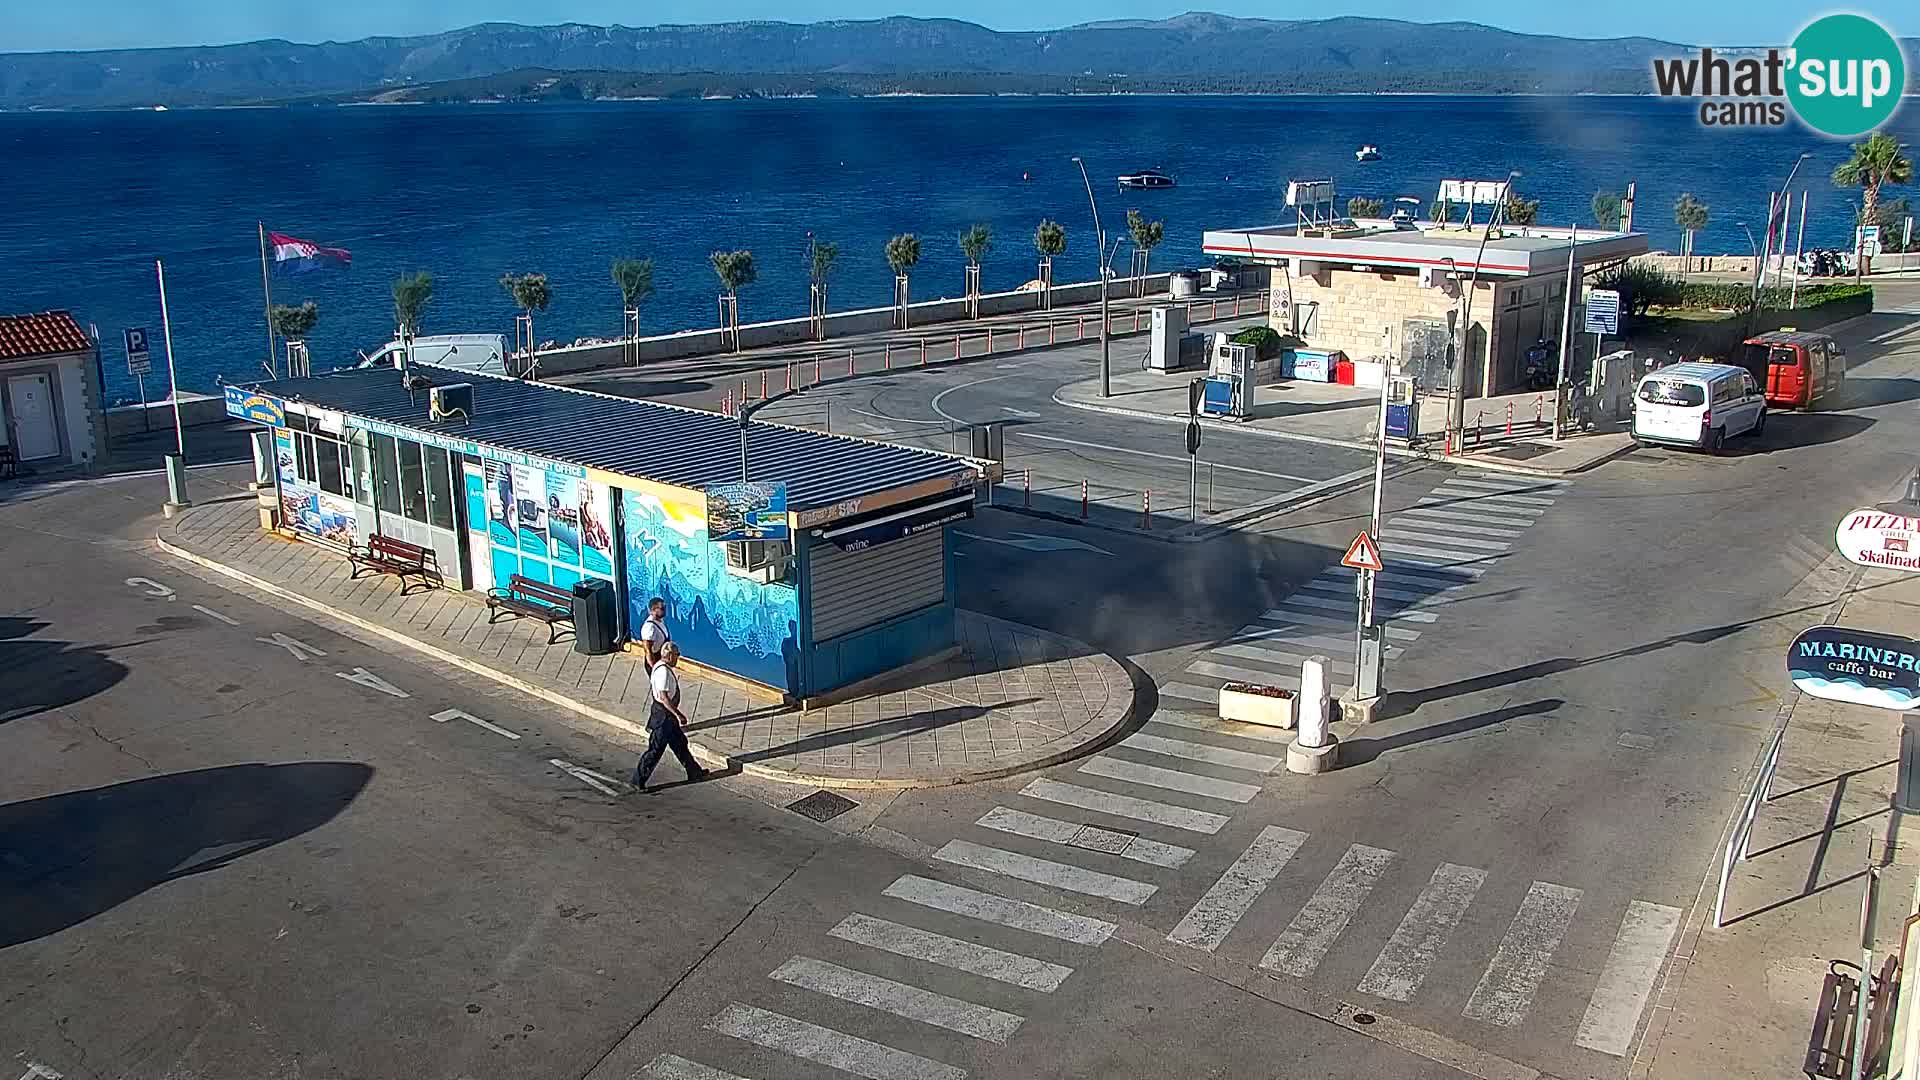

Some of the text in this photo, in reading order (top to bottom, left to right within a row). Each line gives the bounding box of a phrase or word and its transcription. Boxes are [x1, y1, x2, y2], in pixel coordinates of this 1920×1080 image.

[130, 332, 142, 349] P
[493, 448, 526, 465] STATION
[527, 456, 553, 472] TICKET
[554, 463, 582, 477] OFFICE
[1848, 515, 1920, 533] PIZZE
[1828, 659, 1896, 680] caffe bar
